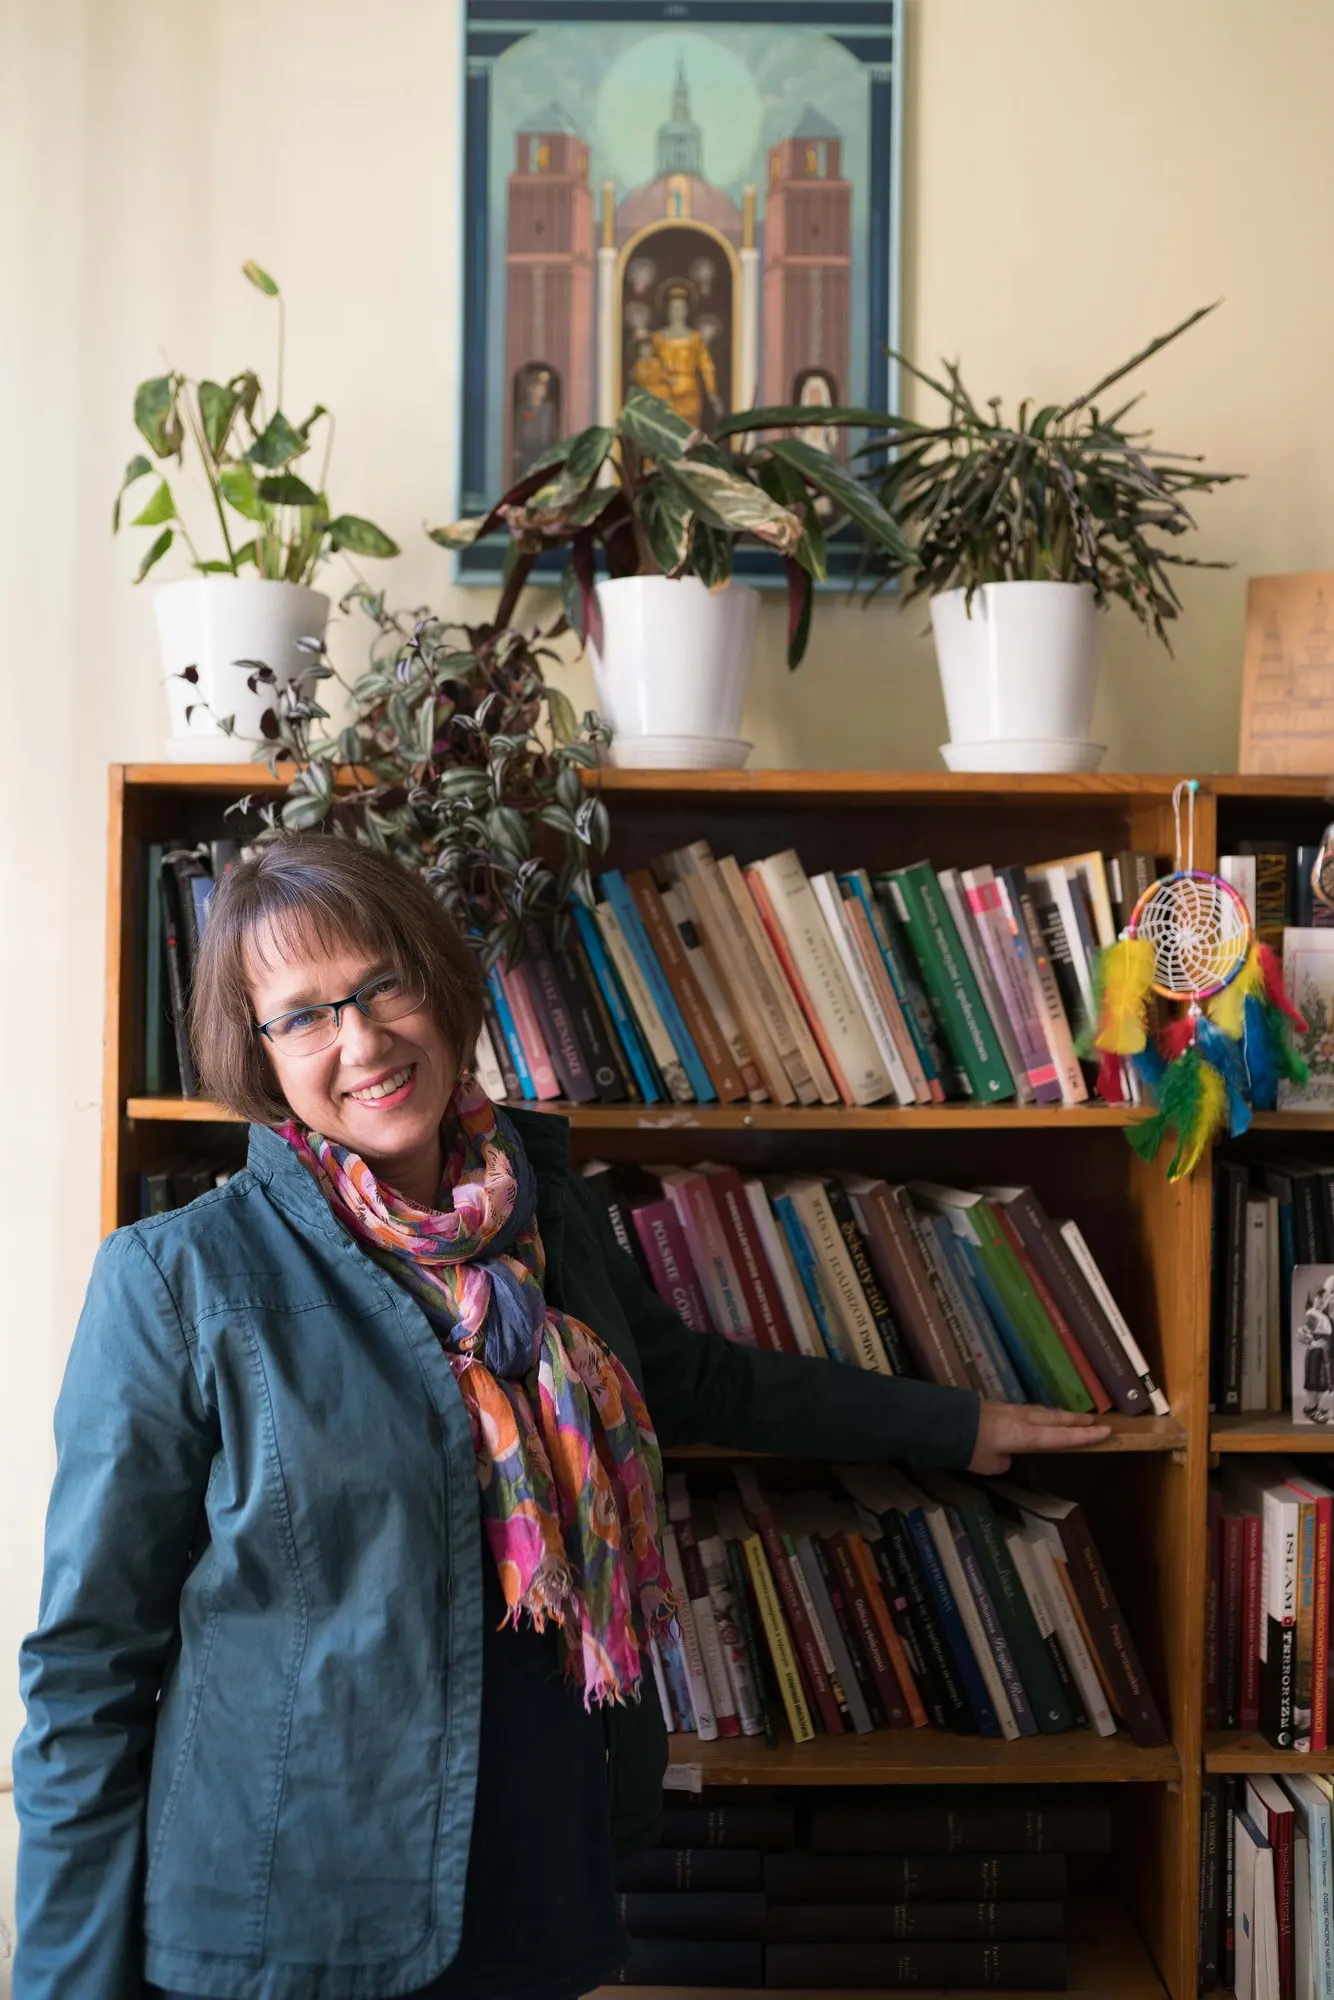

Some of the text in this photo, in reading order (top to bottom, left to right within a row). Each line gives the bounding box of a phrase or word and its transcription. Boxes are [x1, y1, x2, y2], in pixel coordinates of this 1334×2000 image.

[652, 1219, 681, 1283] POLSKIE
[808, 1196, 837, 1249] LUSTER
[829, 1253, 867, 1328] ROZBITYCH
[840, 1219, 890, 1317] Sekrety ziół
[1283, 1532, 1294, 1610] ISLAM
[1279, 1630, 1292, 1728] TERRORYZM
[1314, 1669, 1324, 1732] MARGINALNYCH
[1277, 1842, 1292, 1934] W teatrze piosenki
